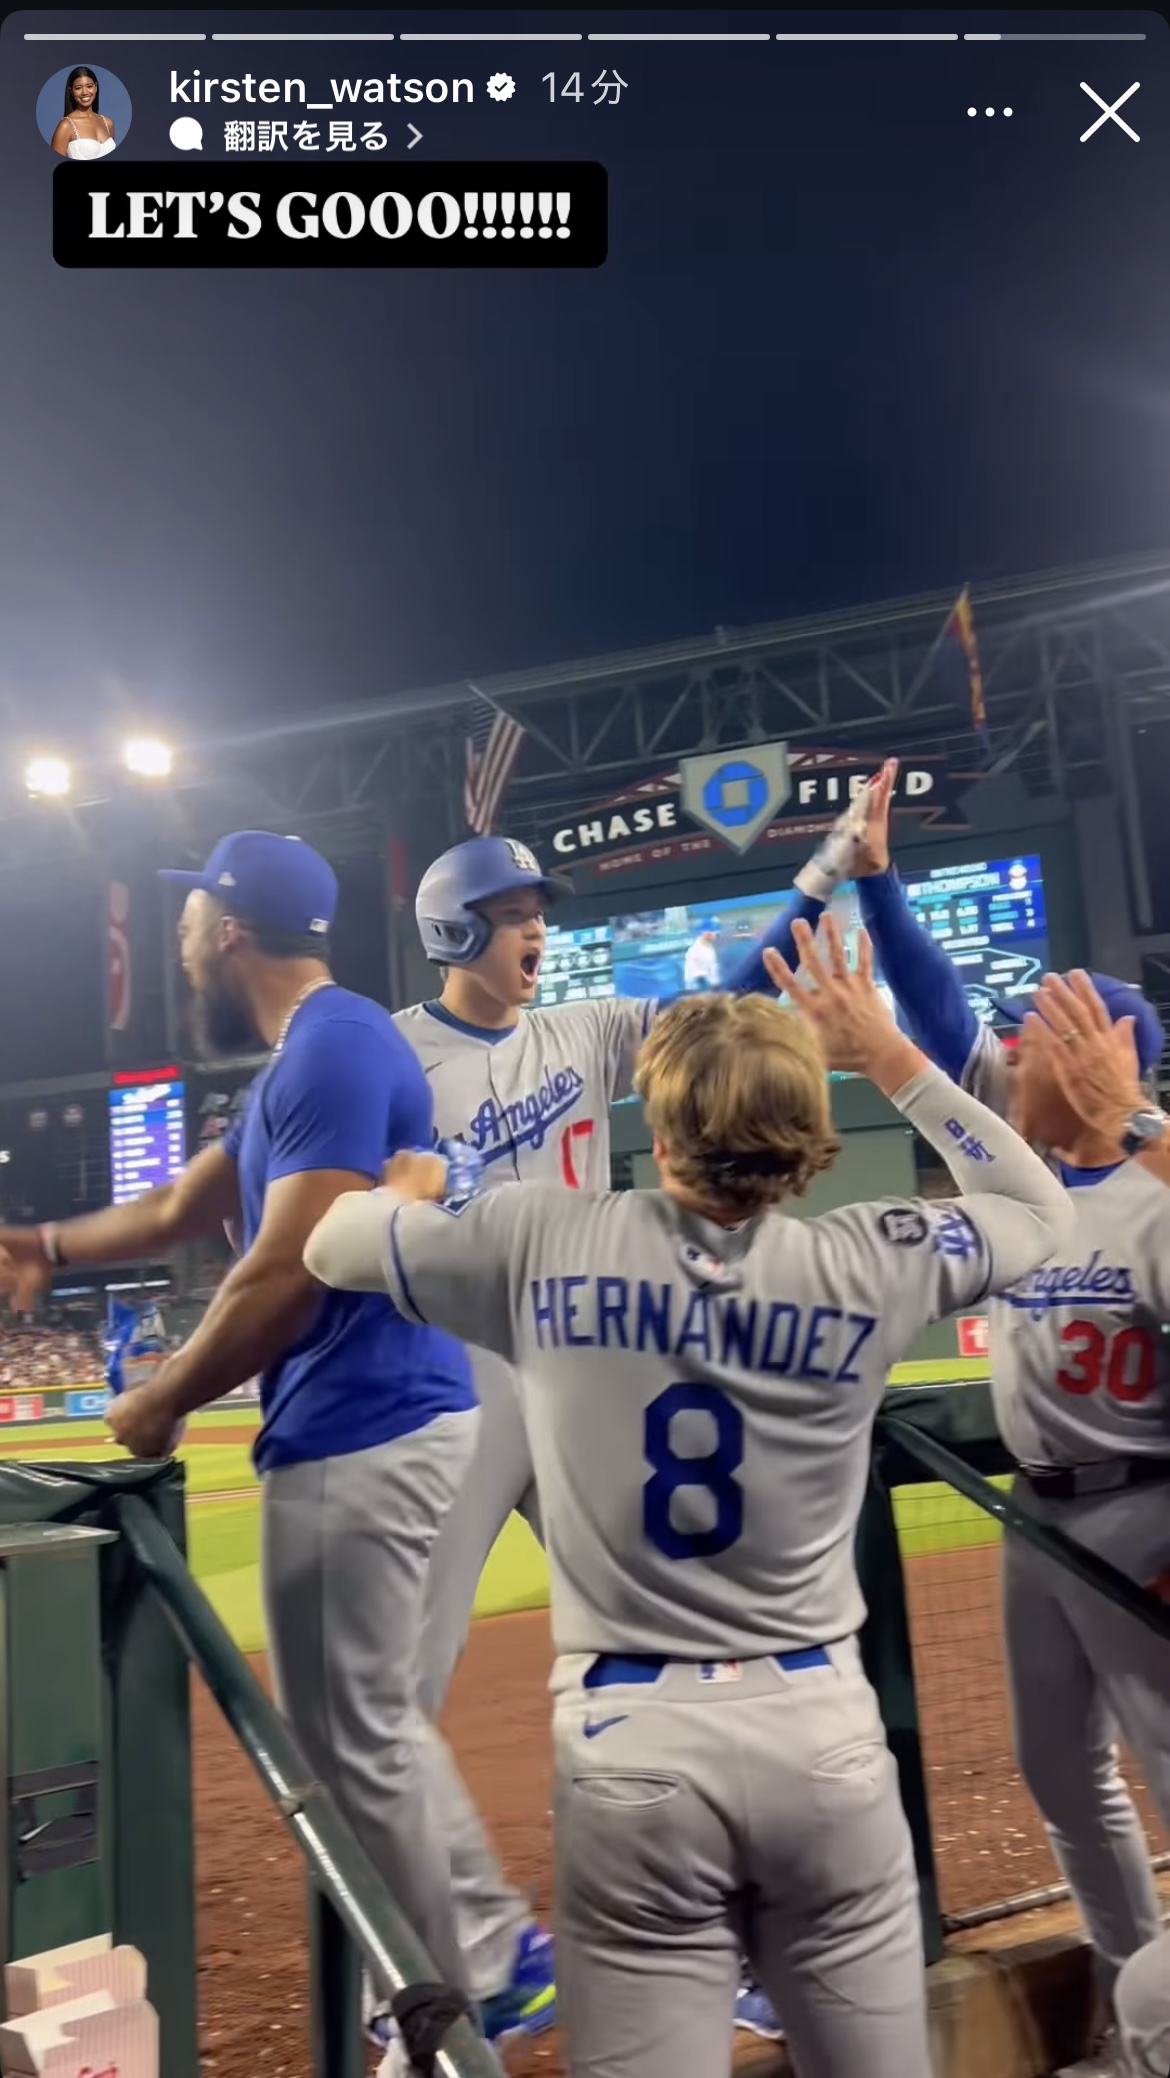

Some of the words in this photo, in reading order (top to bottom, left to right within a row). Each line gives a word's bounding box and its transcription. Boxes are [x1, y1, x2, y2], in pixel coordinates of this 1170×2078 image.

[553, 803, 677, 853] CHASE
[798, 771, 934, 804] FIED
[599, 855, 642, 871] HOME
[651, 845, 672, 858] OF
[680, 839, 710, 852] THE
[470, 1065, 584, 1150] Angeles
[1018, 1249, 1135, 1322] ngeles
[1055, 1319, 1158, 1403] 30
[642, 1381, 745, 1561] 8
